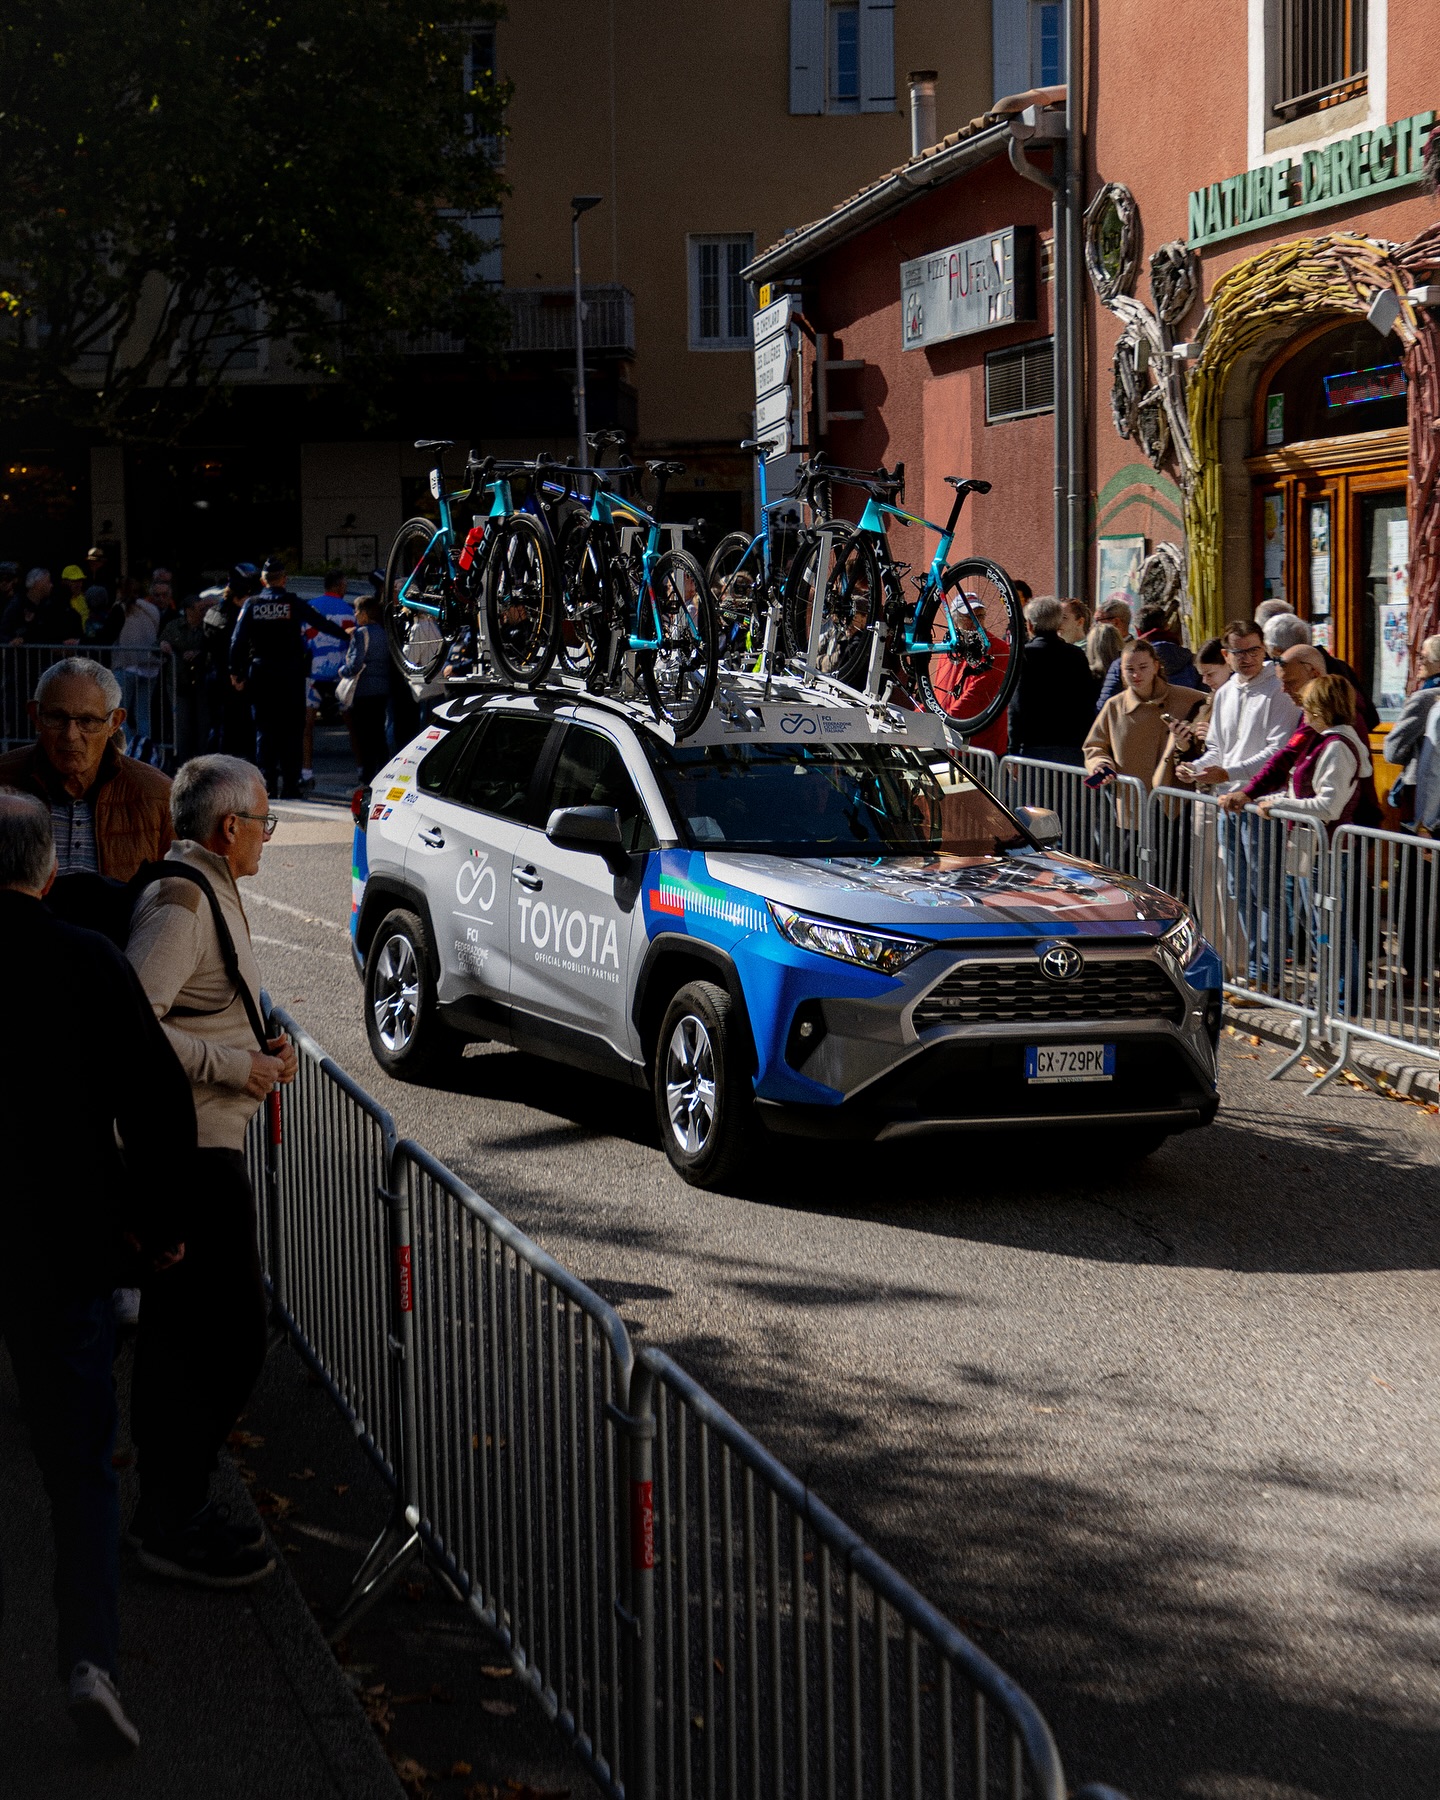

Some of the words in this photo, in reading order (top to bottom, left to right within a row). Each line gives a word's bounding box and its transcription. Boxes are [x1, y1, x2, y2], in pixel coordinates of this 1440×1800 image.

[1188, 158, 1293, 242] NATURE
[1302, 110, 1436, 204] DIRECTE
[949, 249, 969, 300] AU
[252, 603, 291, 615] POLICE
[454, 940, 489, 960] FEDERAZIONE
[466, 927, 479, 942] FCI
[517, 896, 620, 969] TOYOTA
[534, 951, 561, 968] OFFICIAL
[562, 958, 590, 976] MOBILITY
[591, 967, 620, 984] PARTNER
[399, 1264, 409, 1310] ALTRAD
